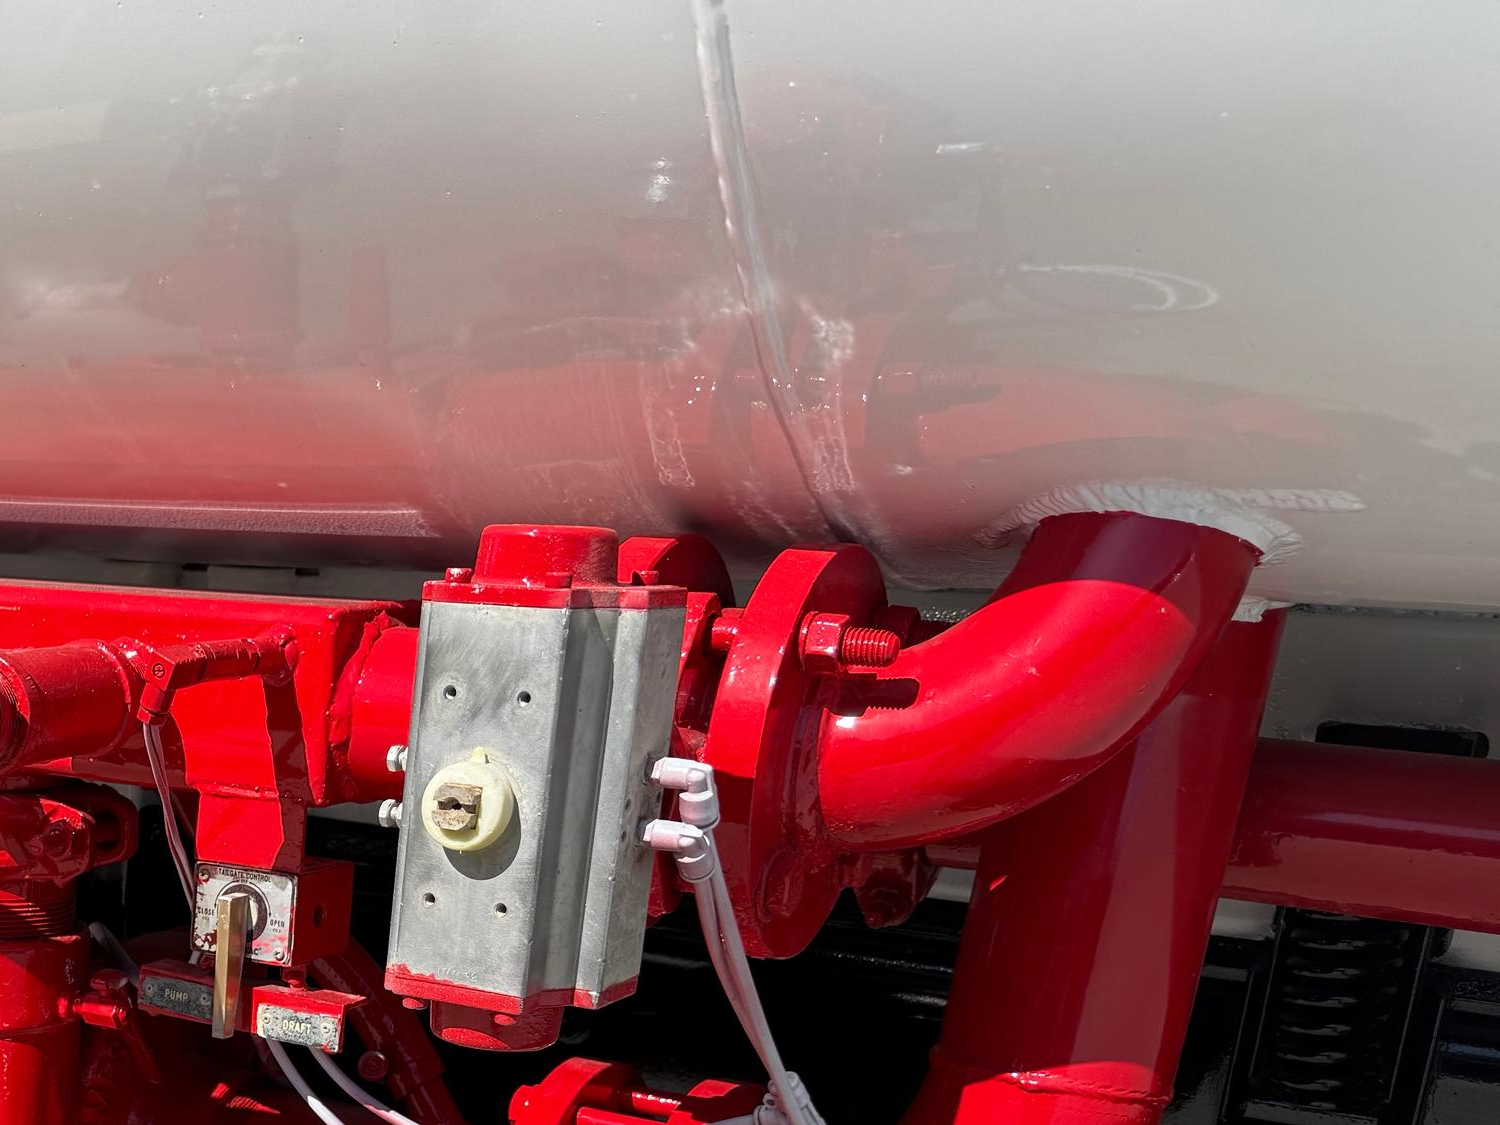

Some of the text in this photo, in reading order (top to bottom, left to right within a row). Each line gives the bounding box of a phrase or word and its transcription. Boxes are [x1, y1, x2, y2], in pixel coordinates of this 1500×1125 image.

[219, 868, 272, 883] TAILGATE CONTROL
[197, 906, 215, 916] CLOSE
[270, 919, 285, 928] OPEN
[163, 988, 189, 1002] PUMP
[282, 1019, 312, 1035] DRAFT
